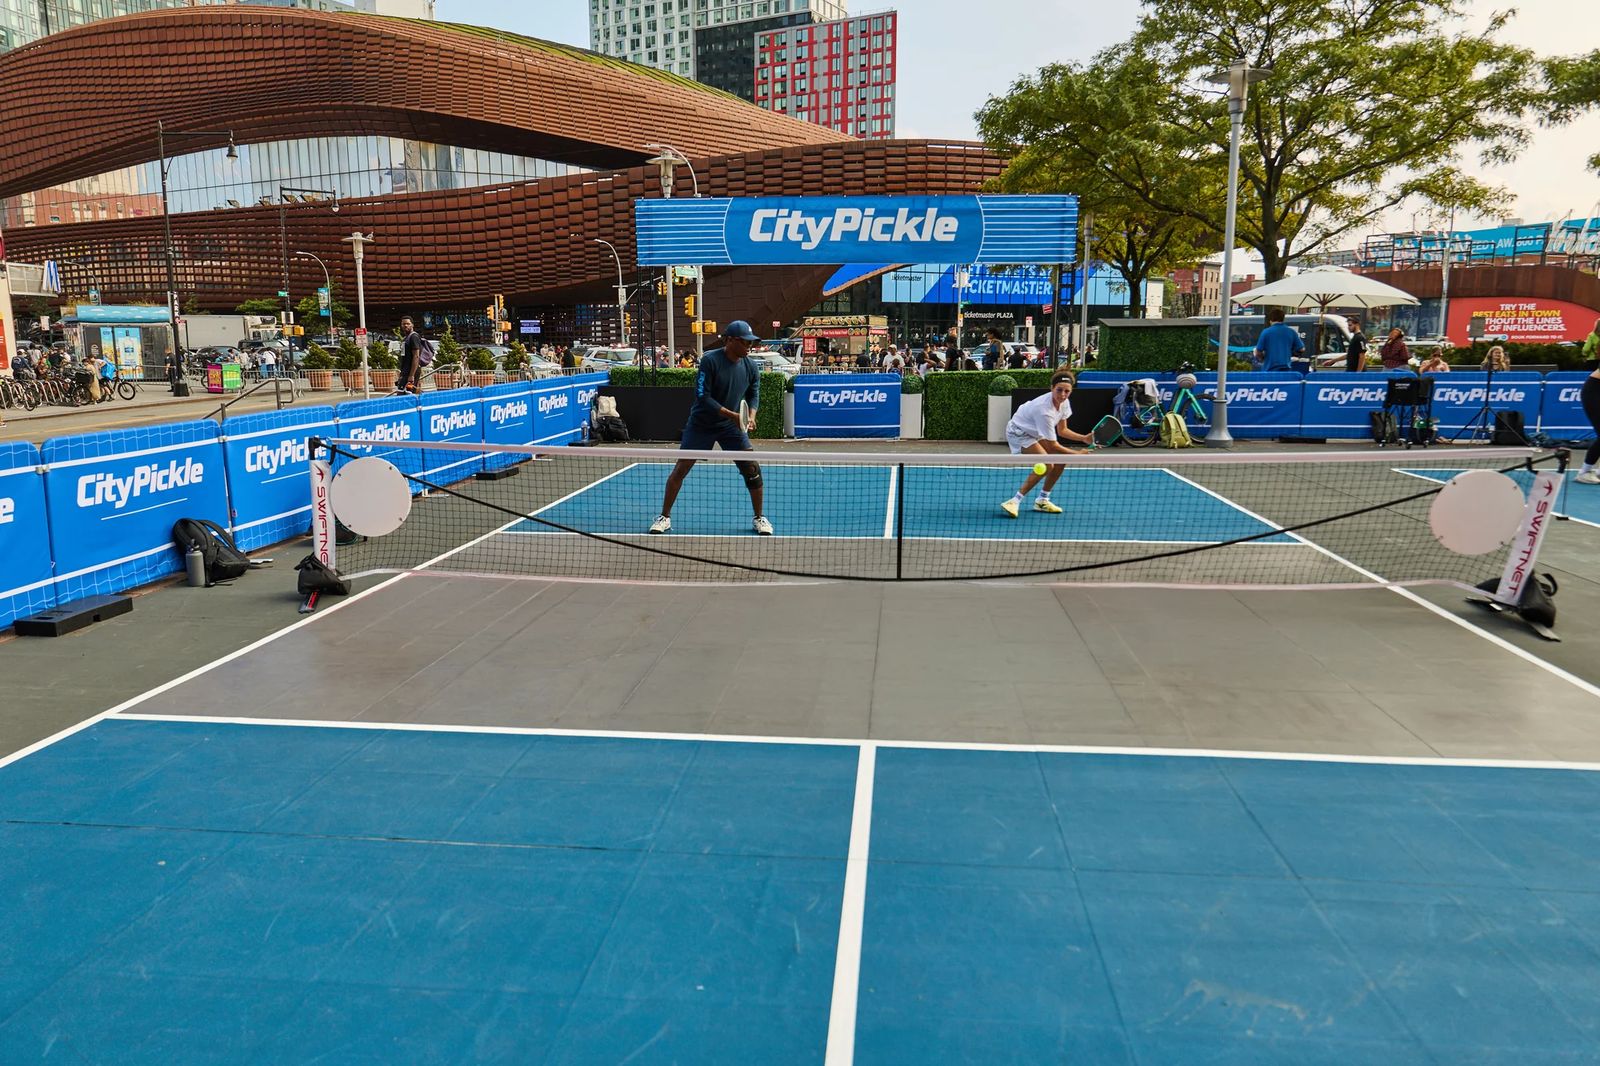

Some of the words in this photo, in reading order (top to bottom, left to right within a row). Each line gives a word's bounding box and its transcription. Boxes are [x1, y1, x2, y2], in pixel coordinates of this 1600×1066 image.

[749, 207, 959, 251] CityPickle
[1495, 310, 1518, 318] EATS
[1518, 310, 1528, 318] IN
[1500, 303, 1516, 311] TRY
[1518, 302, 1536, 310] THE
[1488, 324, 1502, 332] OF
[1503, 324, 1567, 332] INFLUENCERS.
[538, 393, 568, 413] CityPickle
[808, 389, 888, 407] CityPickle
[1318, 388, 1387, 407] CityPick
[1434, 388, 1526, 405] CityPickle
[430, 408, 476, 436] CityPickle
[490, 400, 528, 424] CityPickle
[350, 420, 410, 453] CityPickle
[77, 456, 204, 509] CityPickle
[316, 486, 329, 568] SWIFTNE
[1508, 500, 1548, 598] SWIFTNET
